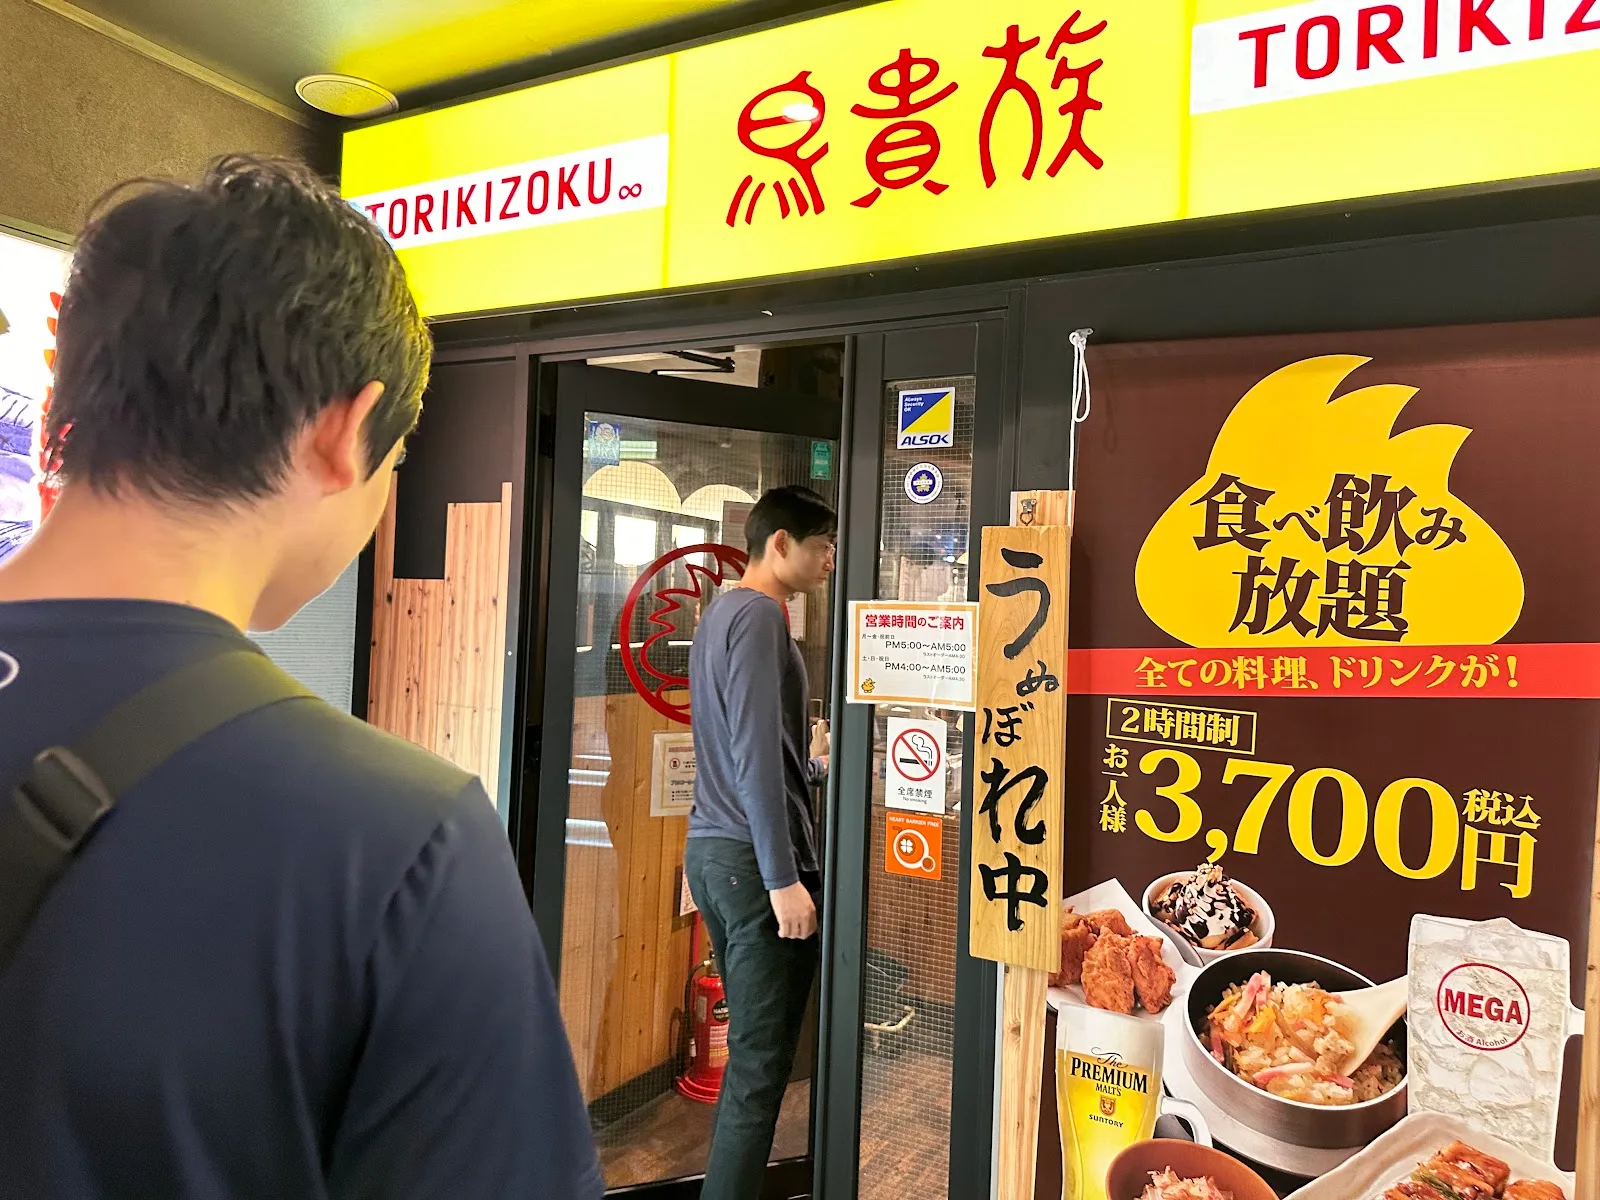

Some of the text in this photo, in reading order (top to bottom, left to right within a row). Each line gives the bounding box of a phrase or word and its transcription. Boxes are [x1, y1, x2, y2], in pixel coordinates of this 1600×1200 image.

[726, 10, 1107, 228] 鳥貴族
[901, 434, 949, 446] ALSOK
[1190, 473, 1467, 557] 食べ飲み
[1228, 555, 1412, 643] 放題
[866, 615, 964, 630] 営業時間のご案内
[977, 547, 1060, 932] うぬぼれ中
[1121, 706, 1240, 748] 2時間制
[897, 786, 933, 799] 全席禁煙
[1099, 743, 1129, 834] お一人様
[1461, 787, 1542, 830] 税込
[1443, 988, 1523, 1026] MEGA
[1091, 1047, 1128, 1069] The
[1475, 1036, 1508, 1047] Alcohol
[1070, 1056, 1148, 1095] PREMIUM
